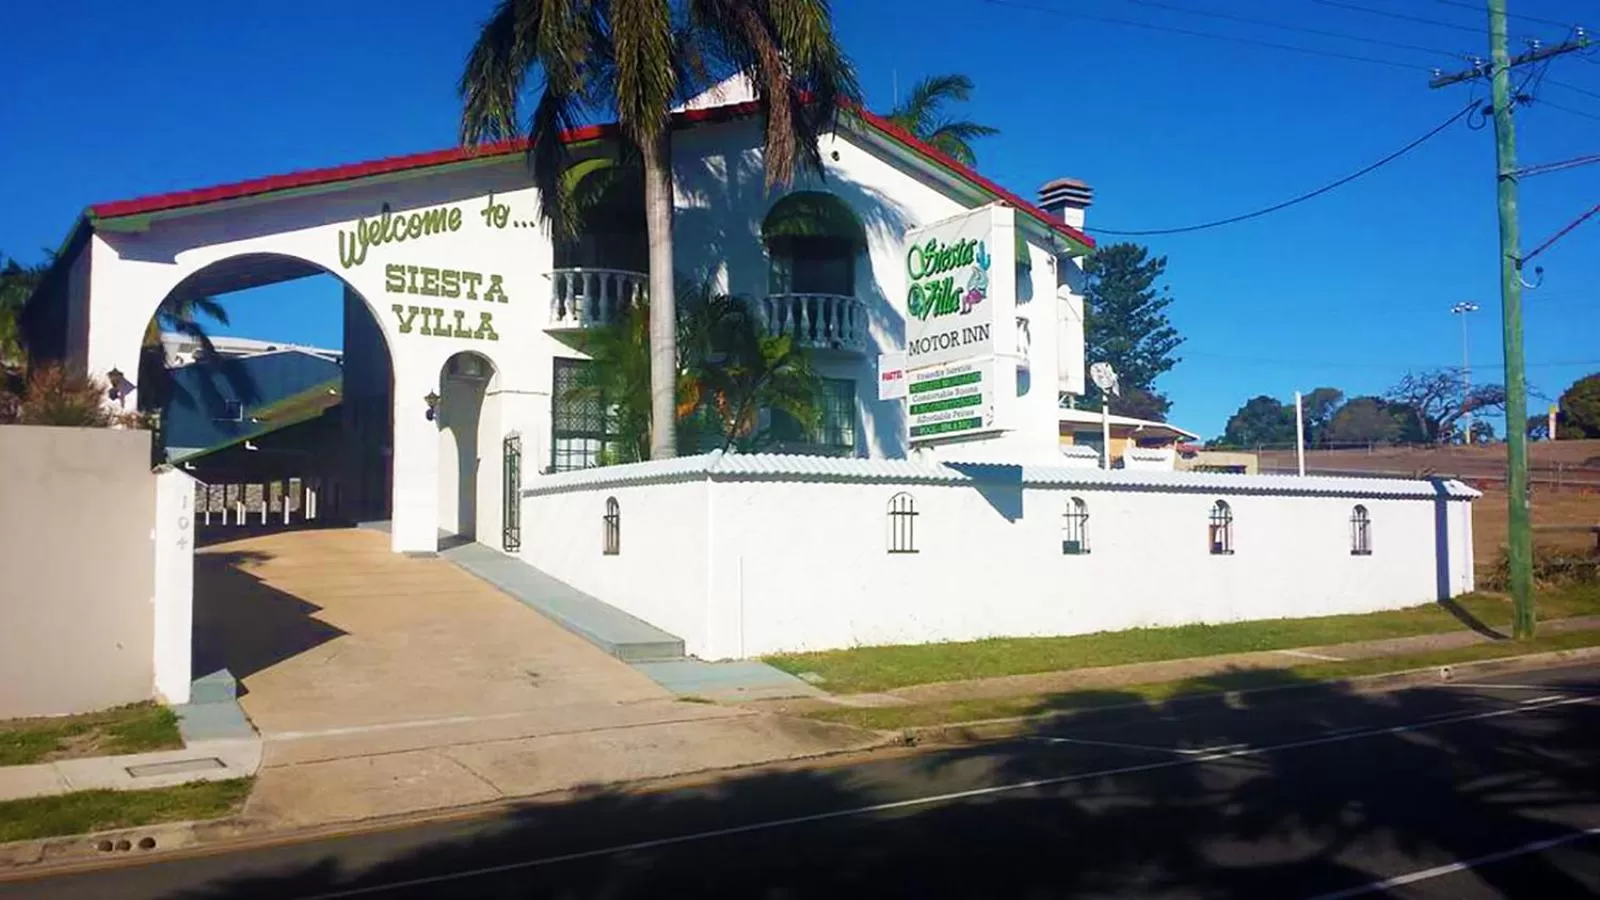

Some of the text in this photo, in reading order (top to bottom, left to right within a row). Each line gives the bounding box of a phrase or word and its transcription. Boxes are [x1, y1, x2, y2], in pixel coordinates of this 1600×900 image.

[338, 201, 462, 269] Welcome
[907, 238, 978, 281] Siesta
[385, 263, 509, 303] SIESTA
[907, 276, 964, 321] Villa
[391, 303, 499, 341] VILLA
[909, 323, 990, 356] MOTOR INN
[912, 386, 979, 402] Comfortable Rooms
